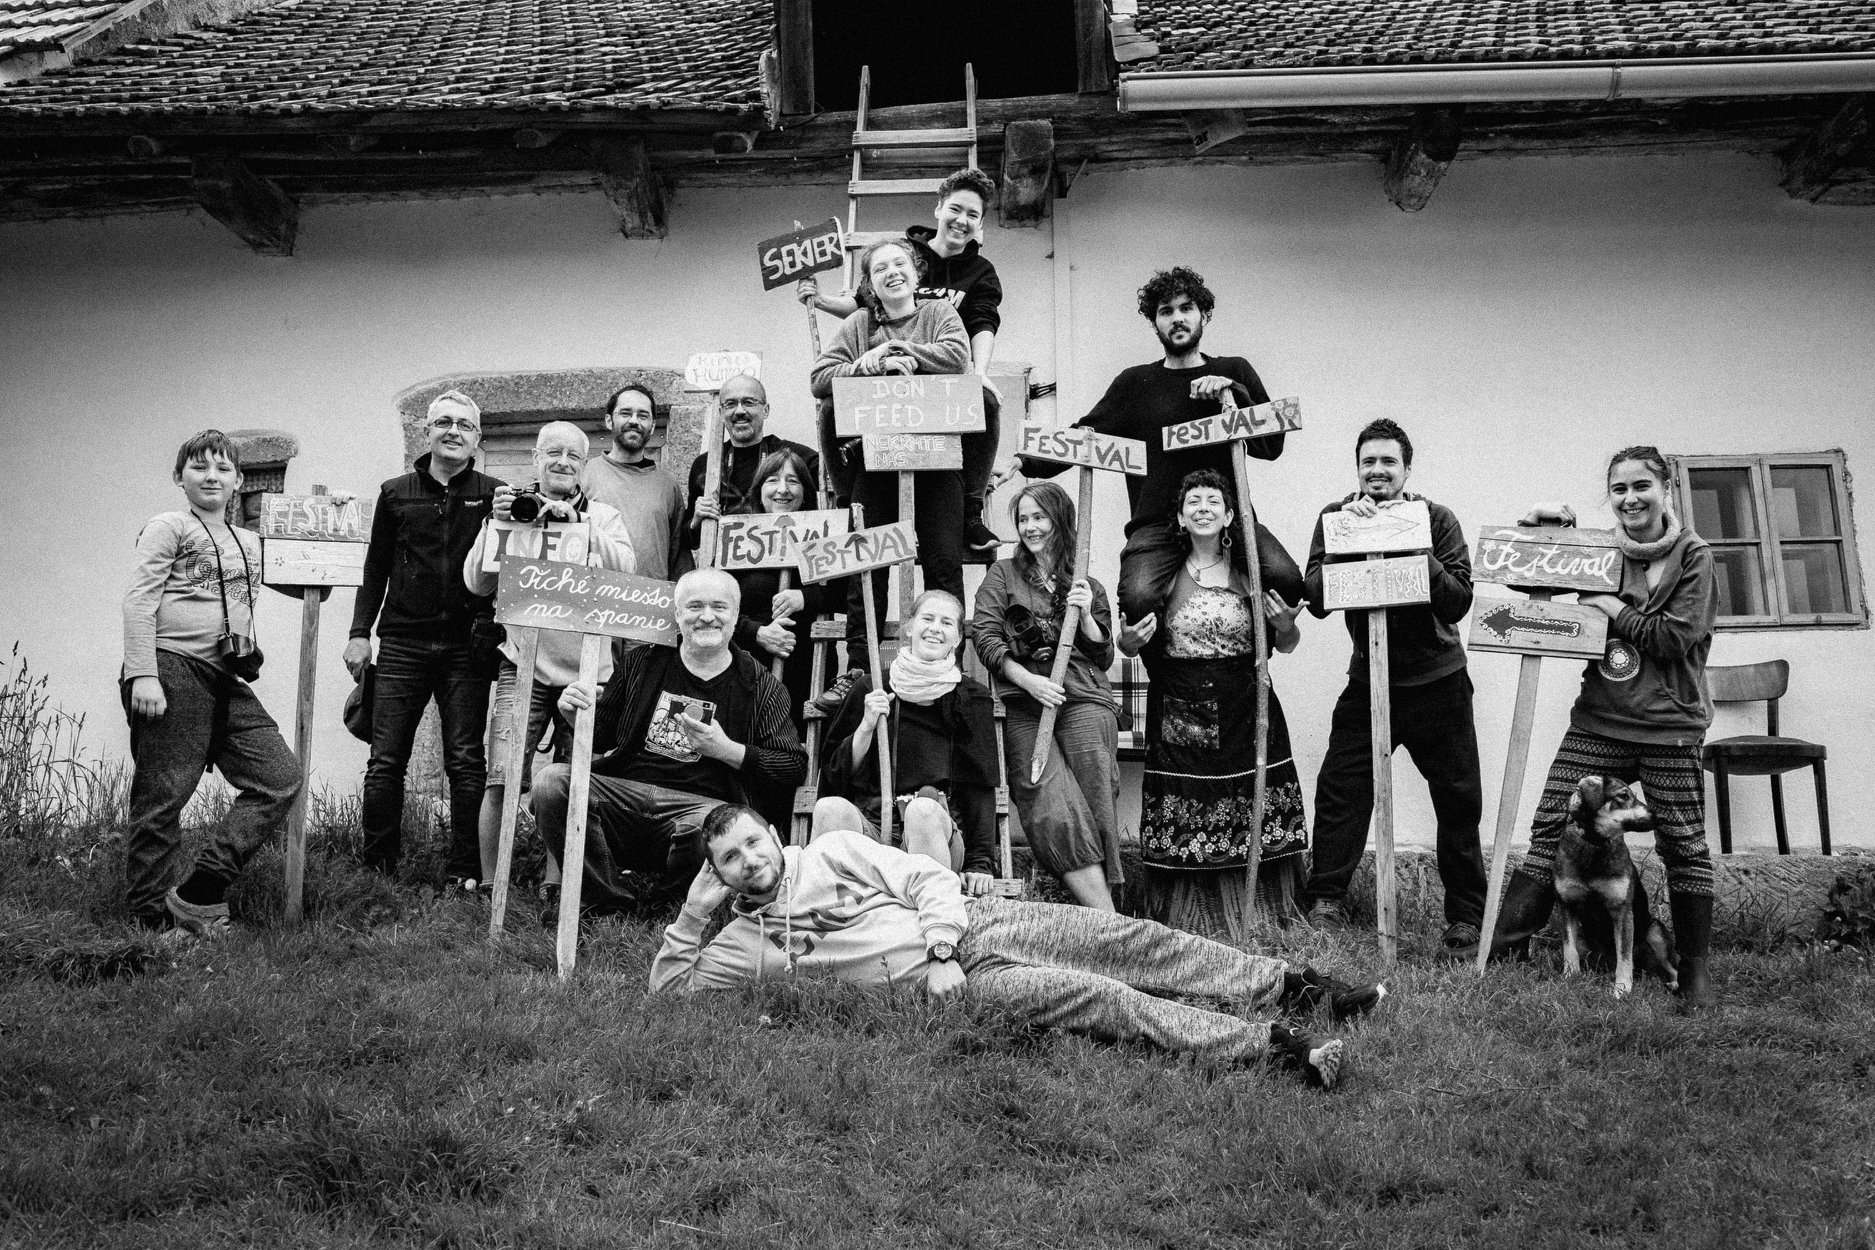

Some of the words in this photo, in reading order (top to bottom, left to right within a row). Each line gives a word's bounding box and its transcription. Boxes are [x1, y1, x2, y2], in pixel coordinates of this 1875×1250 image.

[854, 403, 924, 431] FEED
[945, 402, 978, 426] US
[268, 497, 370, 537] FESTIVAL
[493, 528, 587, 562] INFO
[1482, 529, 1617, 585] Festival
[524, 603, 573, 618] na
[584, 608, 671, 631] spanie
